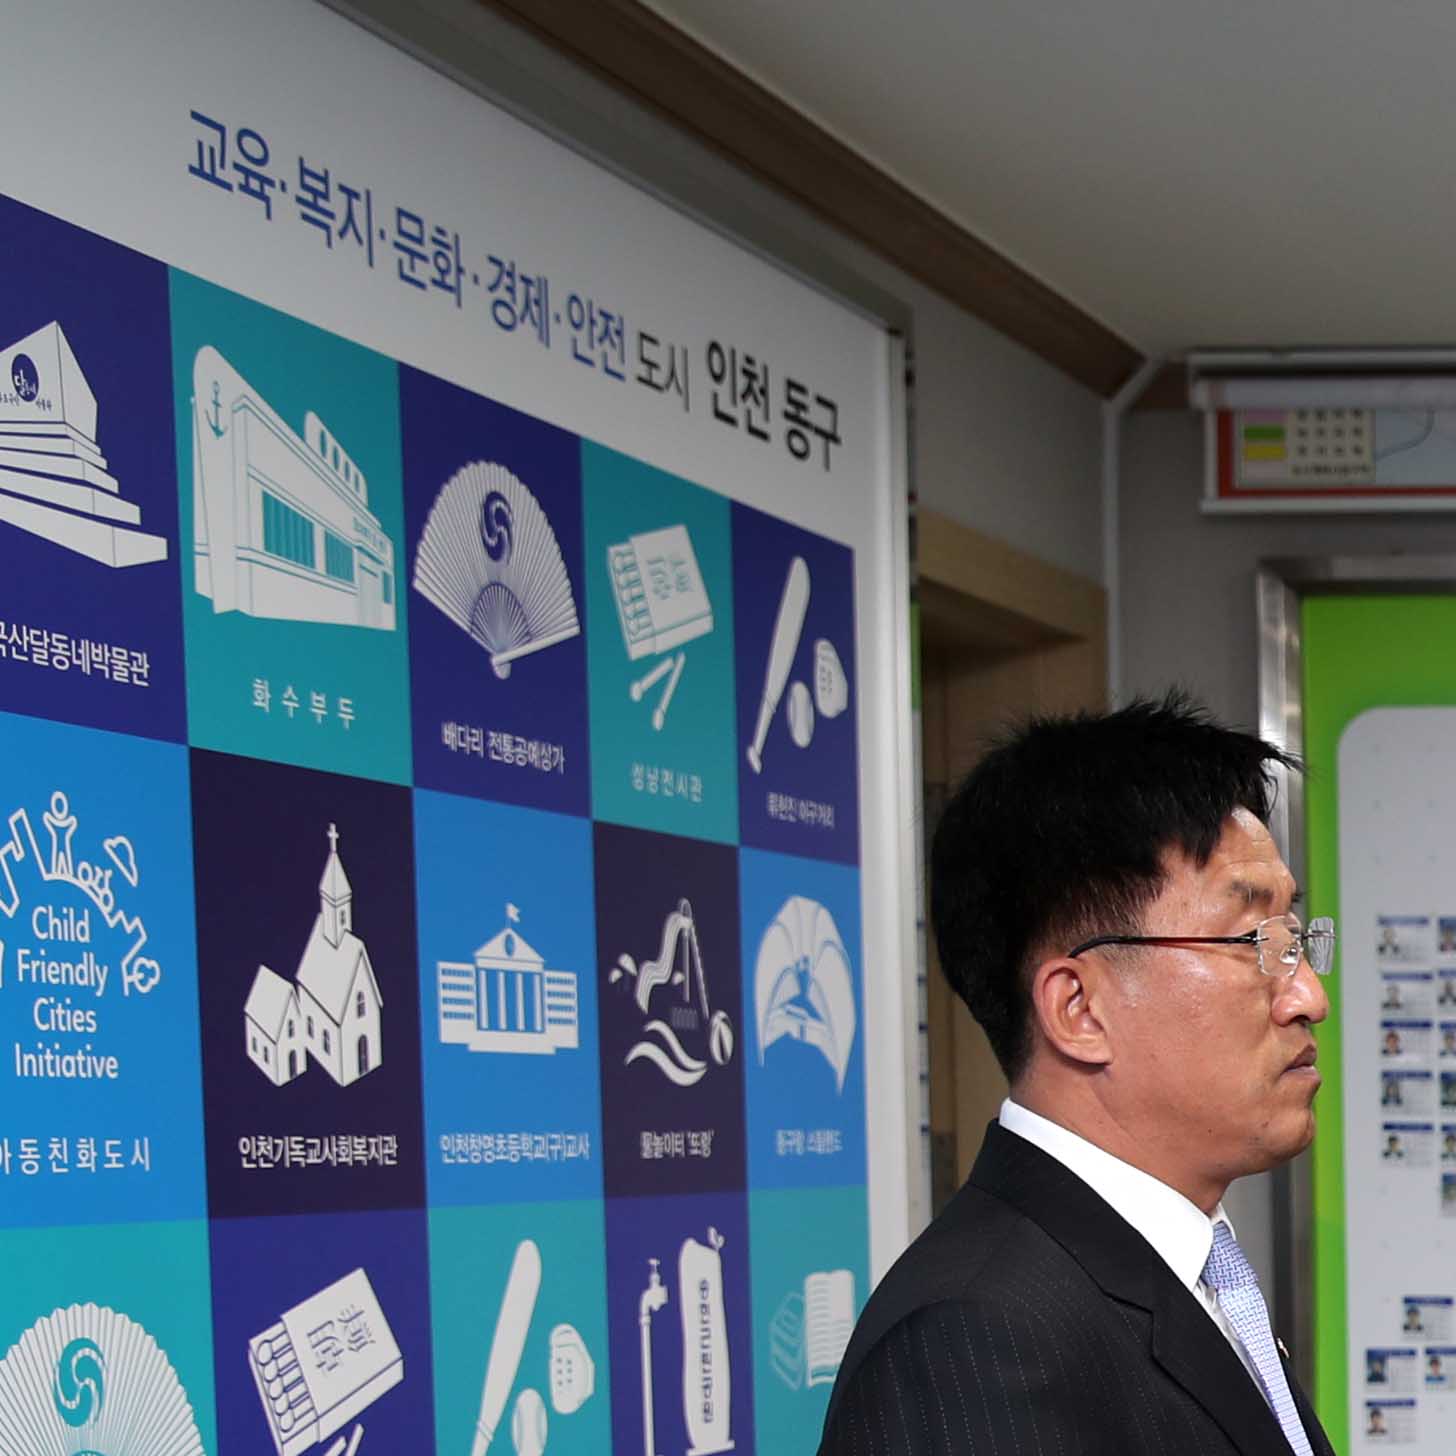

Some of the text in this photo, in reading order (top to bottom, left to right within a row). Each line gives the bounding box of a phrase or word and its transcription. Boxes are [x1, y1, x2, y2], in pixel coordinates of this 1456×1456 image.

[636, 330, 691, 413] 도시
[706, 339, 771, 443] 인천
[785, 376, 842, 473] 동구
[441, 721, 565, 775] 배다리 전통공예상가
[32, 904, 91, 944] Child
[16, 948, 109, 997] Friendly
[33, 997, 98, 1034] Cities
[14, 1042, 120, 1080] Initiative
[238, 1134, 400, 1170] 인천기독교사회복지관
[439, 1132, 591, 1165] 인천창영초등학교(구)교사
